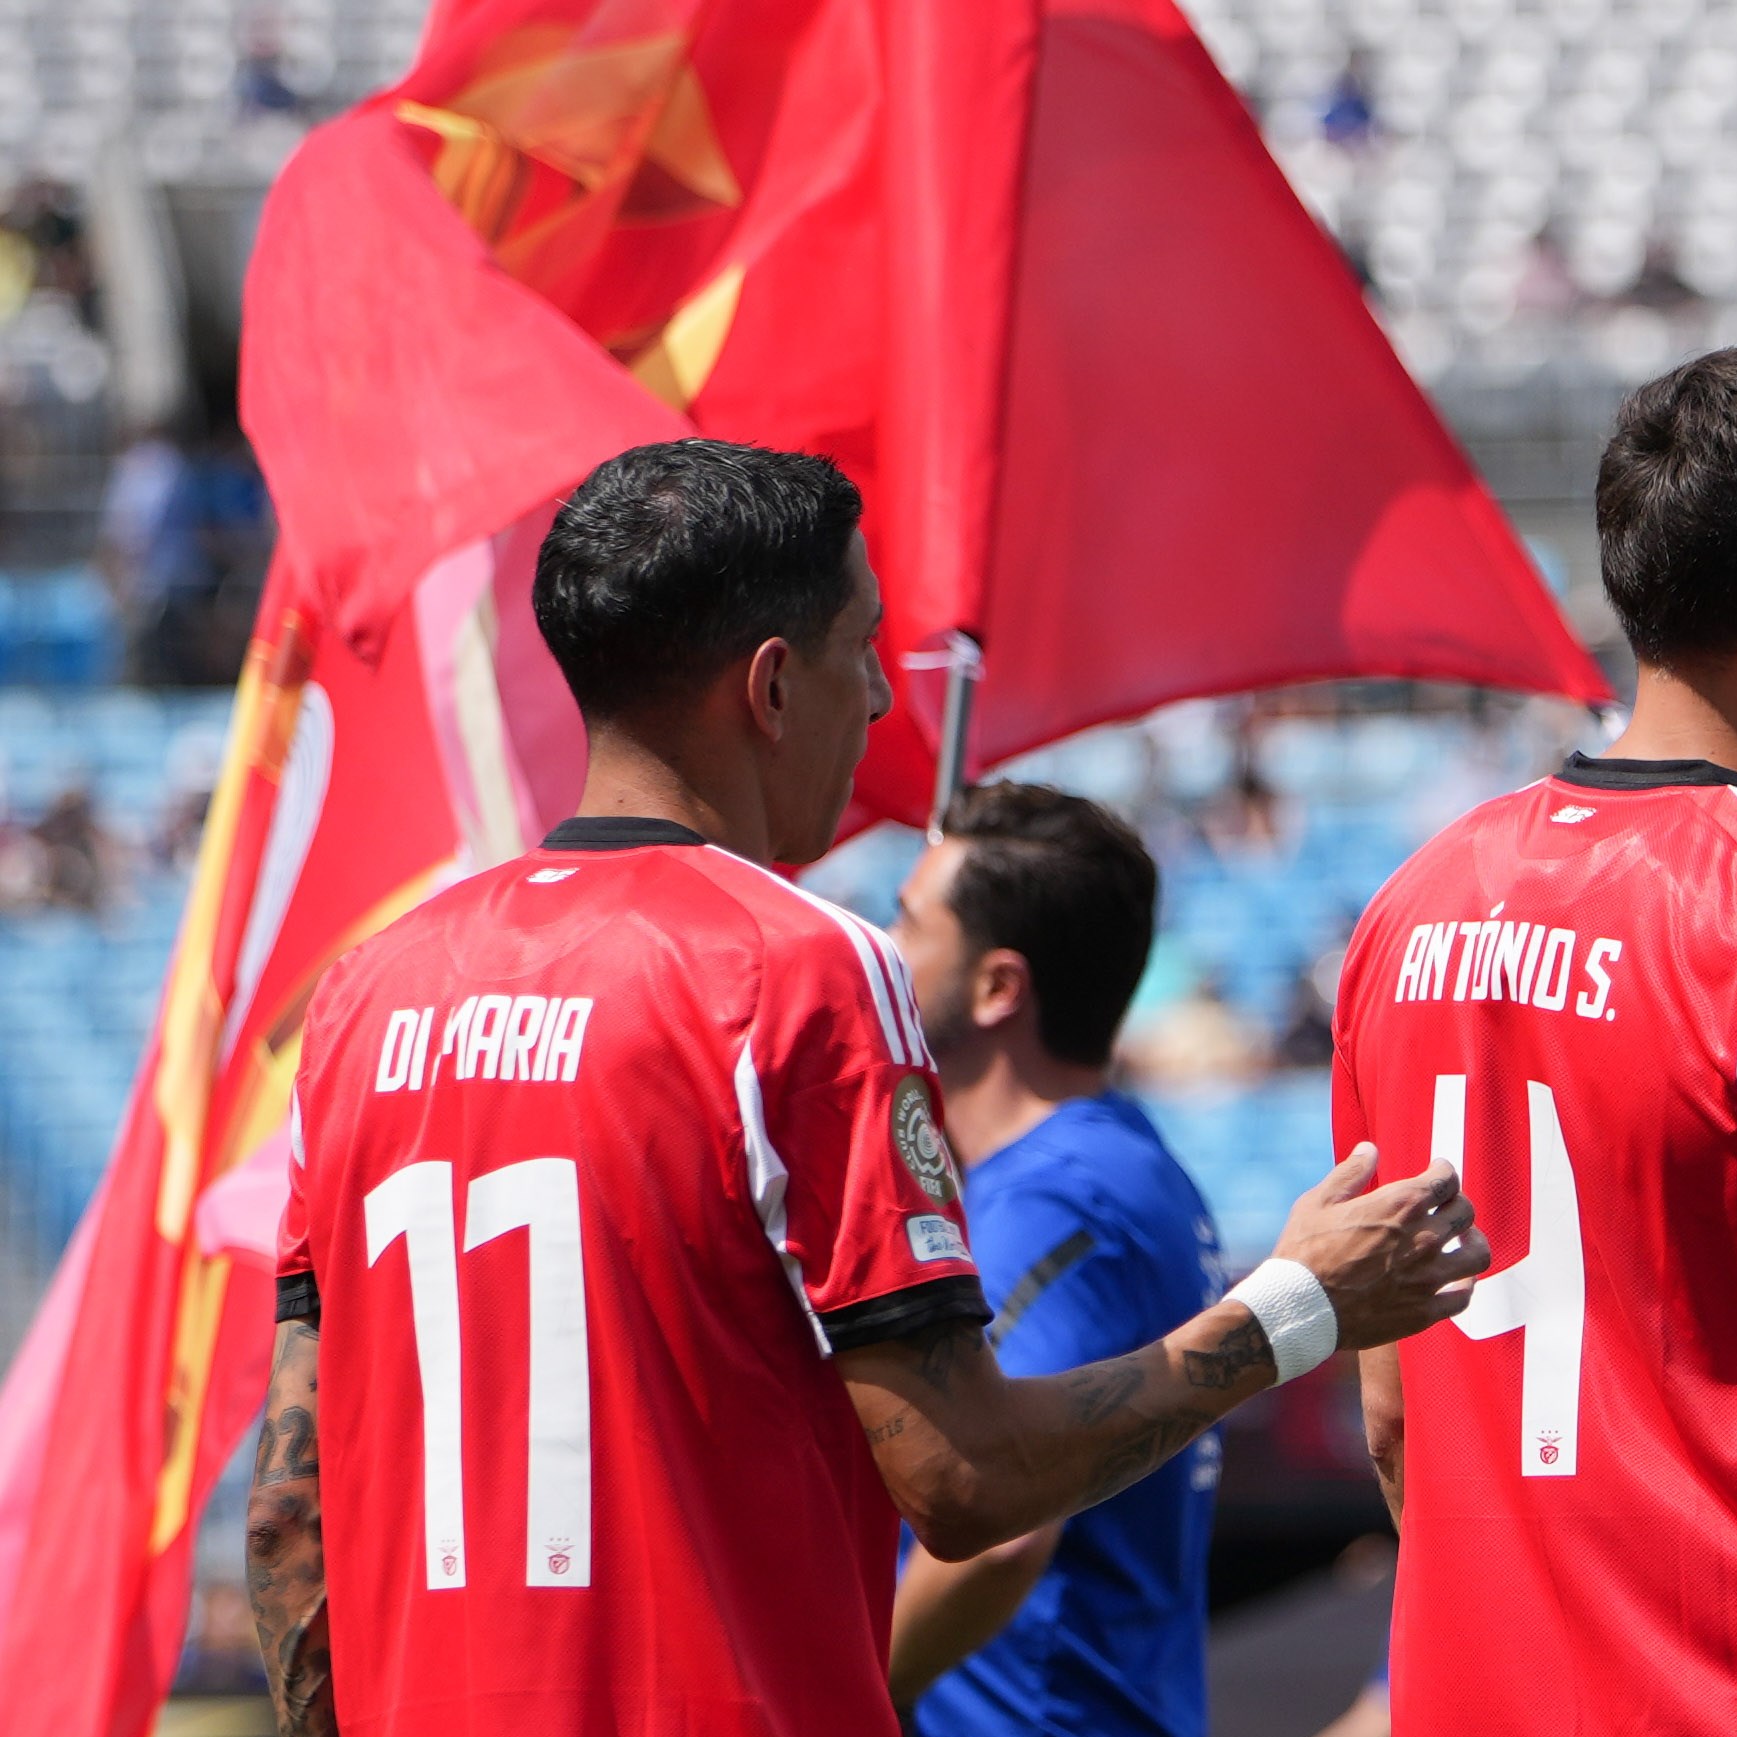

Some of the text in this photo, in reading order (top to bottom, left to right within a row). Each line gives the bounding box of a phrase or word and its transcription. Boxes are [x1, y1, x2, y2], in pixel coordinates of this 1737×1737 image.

[374, 1006, 436, 1093] DI
[1394, 900, 1623, 1022] ANTÓNIO S.
[363, 1156, 592, 1591] 11
[1429, 1074, 1586, 1477] 4
